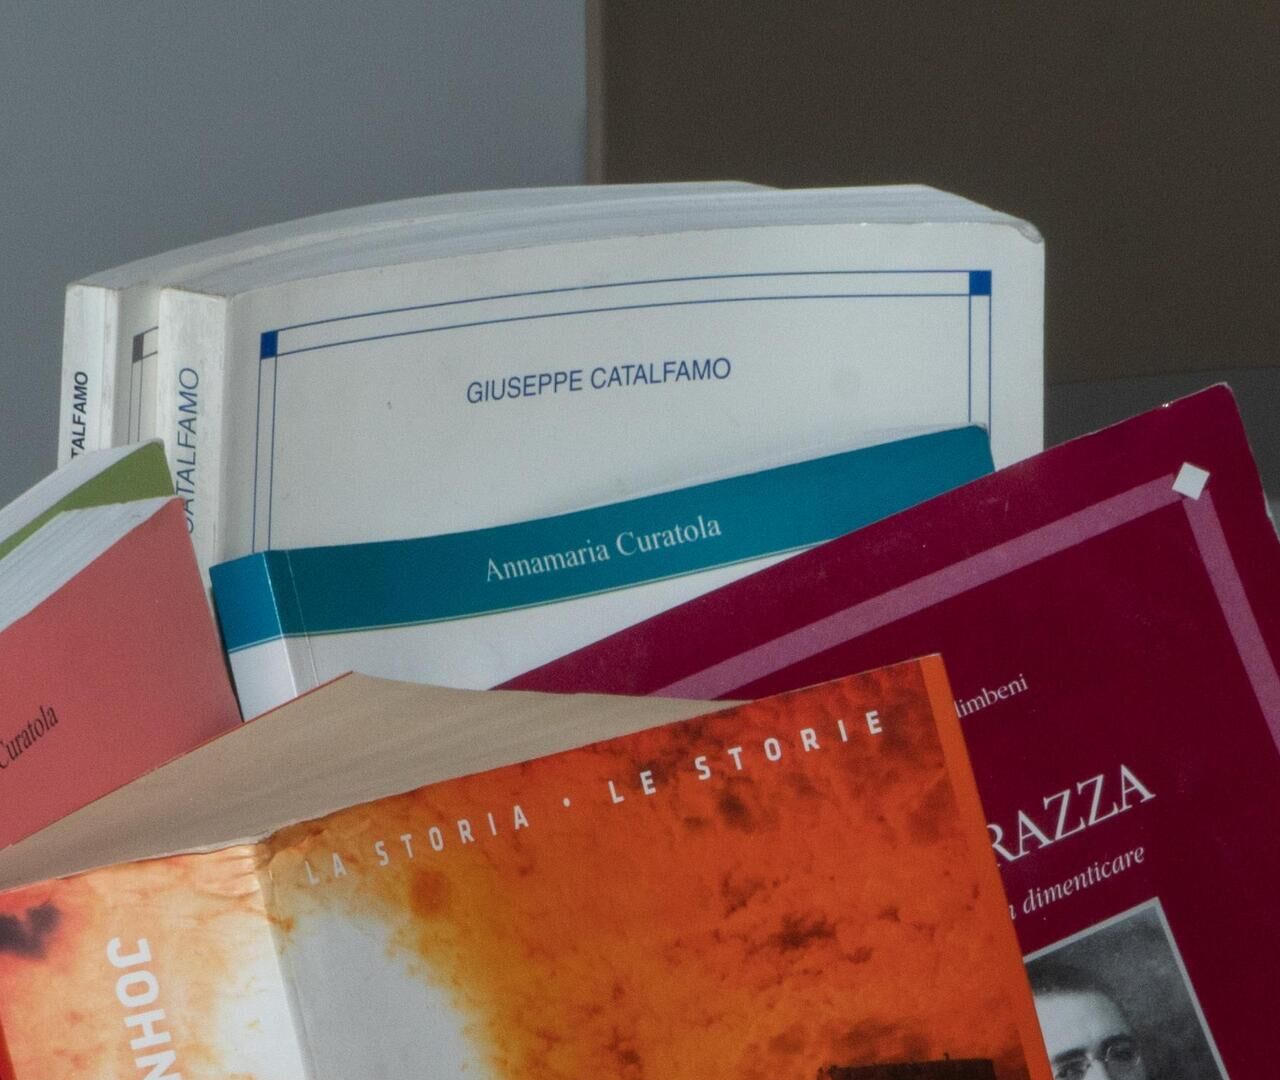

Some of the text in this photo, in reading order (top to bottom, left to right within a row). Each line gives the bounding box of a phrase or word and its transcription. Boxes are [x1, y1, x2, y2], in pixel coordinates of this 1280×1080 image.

[466, 357, 732, 404] GIUSEPPE CATALFAMO
[486, 514, 722, 582] Annamaria Curatola
[305, 709, 883, 887] LA STORIA LE STORIE
[1022, 846, 1146, 915] dimenticare
